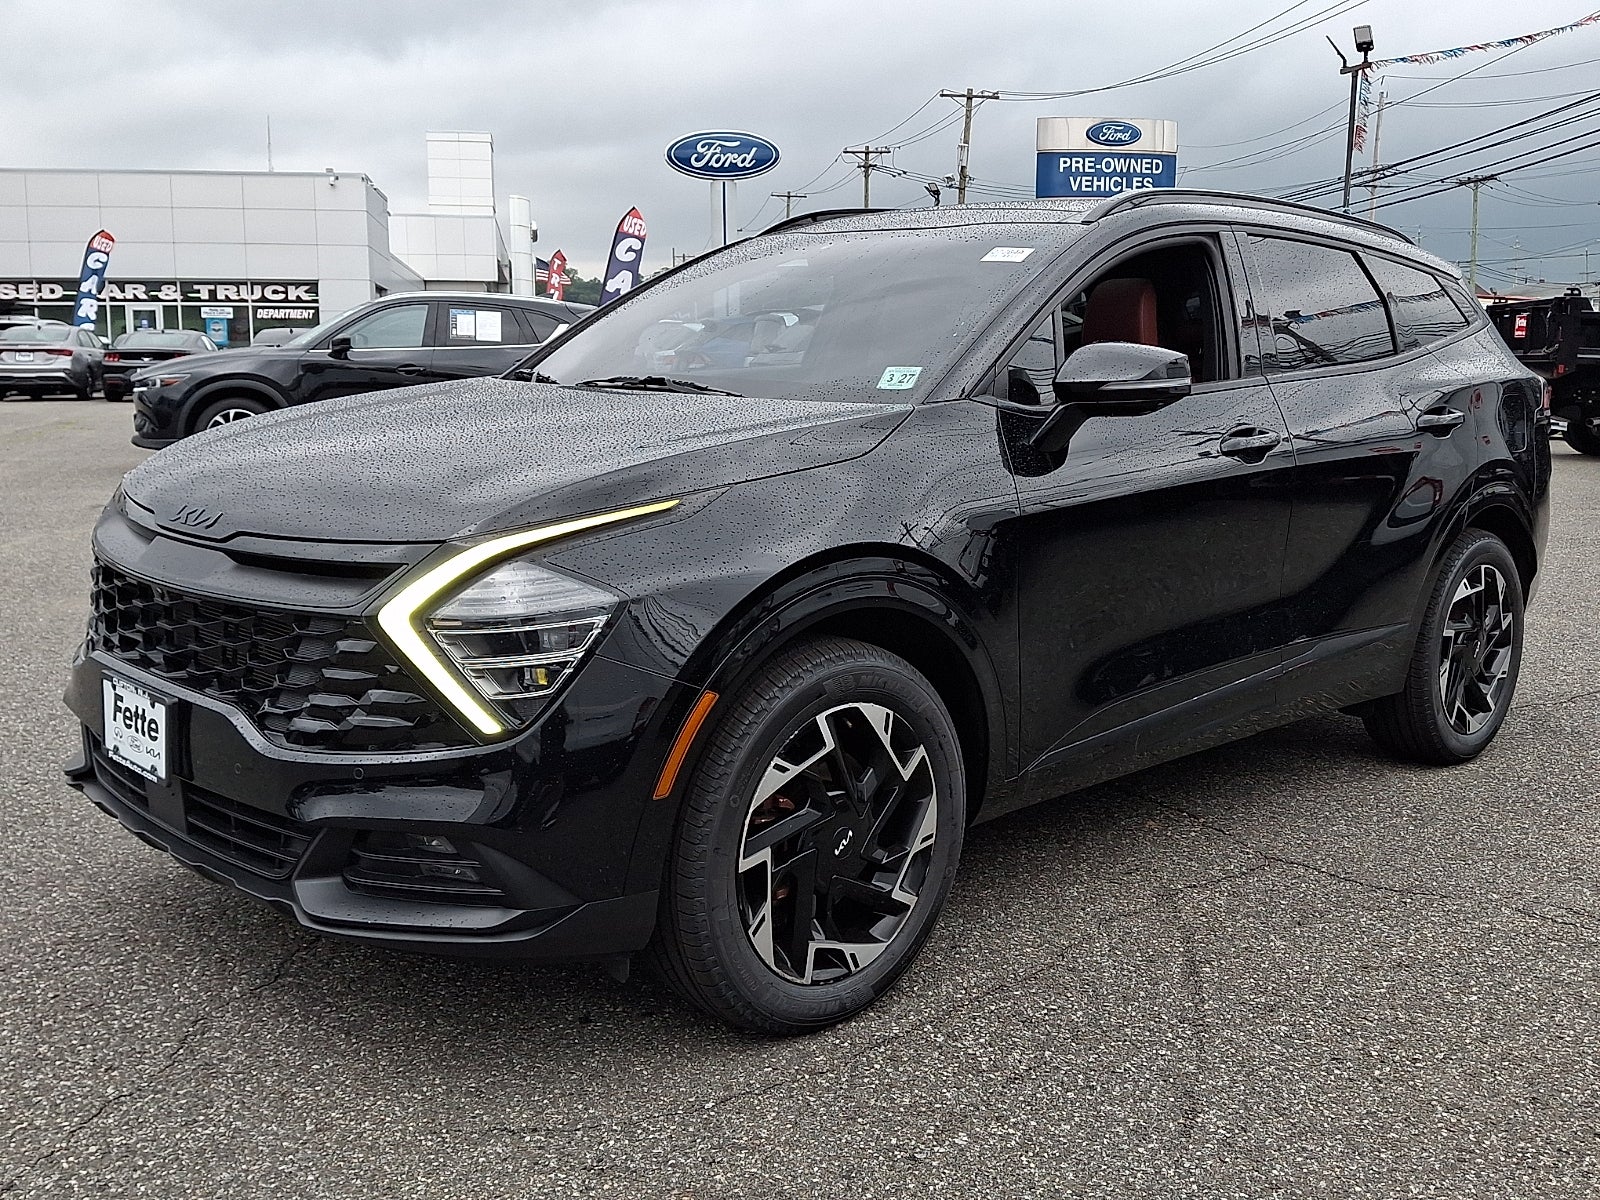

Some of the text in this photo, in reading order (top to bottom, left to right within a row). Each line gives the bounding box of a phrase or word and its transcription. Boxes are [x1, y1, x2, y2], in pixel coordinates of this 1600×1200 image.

[1098, 125, 1132, 141] Ford
[690, 139, 758, 169] Ford
[1059, 157, 1163, 174] PRE-OWNED
[1069, 176, 1153, 191] VEHICLES
[623, 215, 646, 236] USED
[93, 234, 113, 253] USED
[606, 237, 642, 295] CA
[0, 283, 312, 300] SED AR & TRUCK
[256, 308, 315, 319] DEPARTMENT
[886, 373, 916, 384] 3 27
[113, 693, 159, 742] Fette
